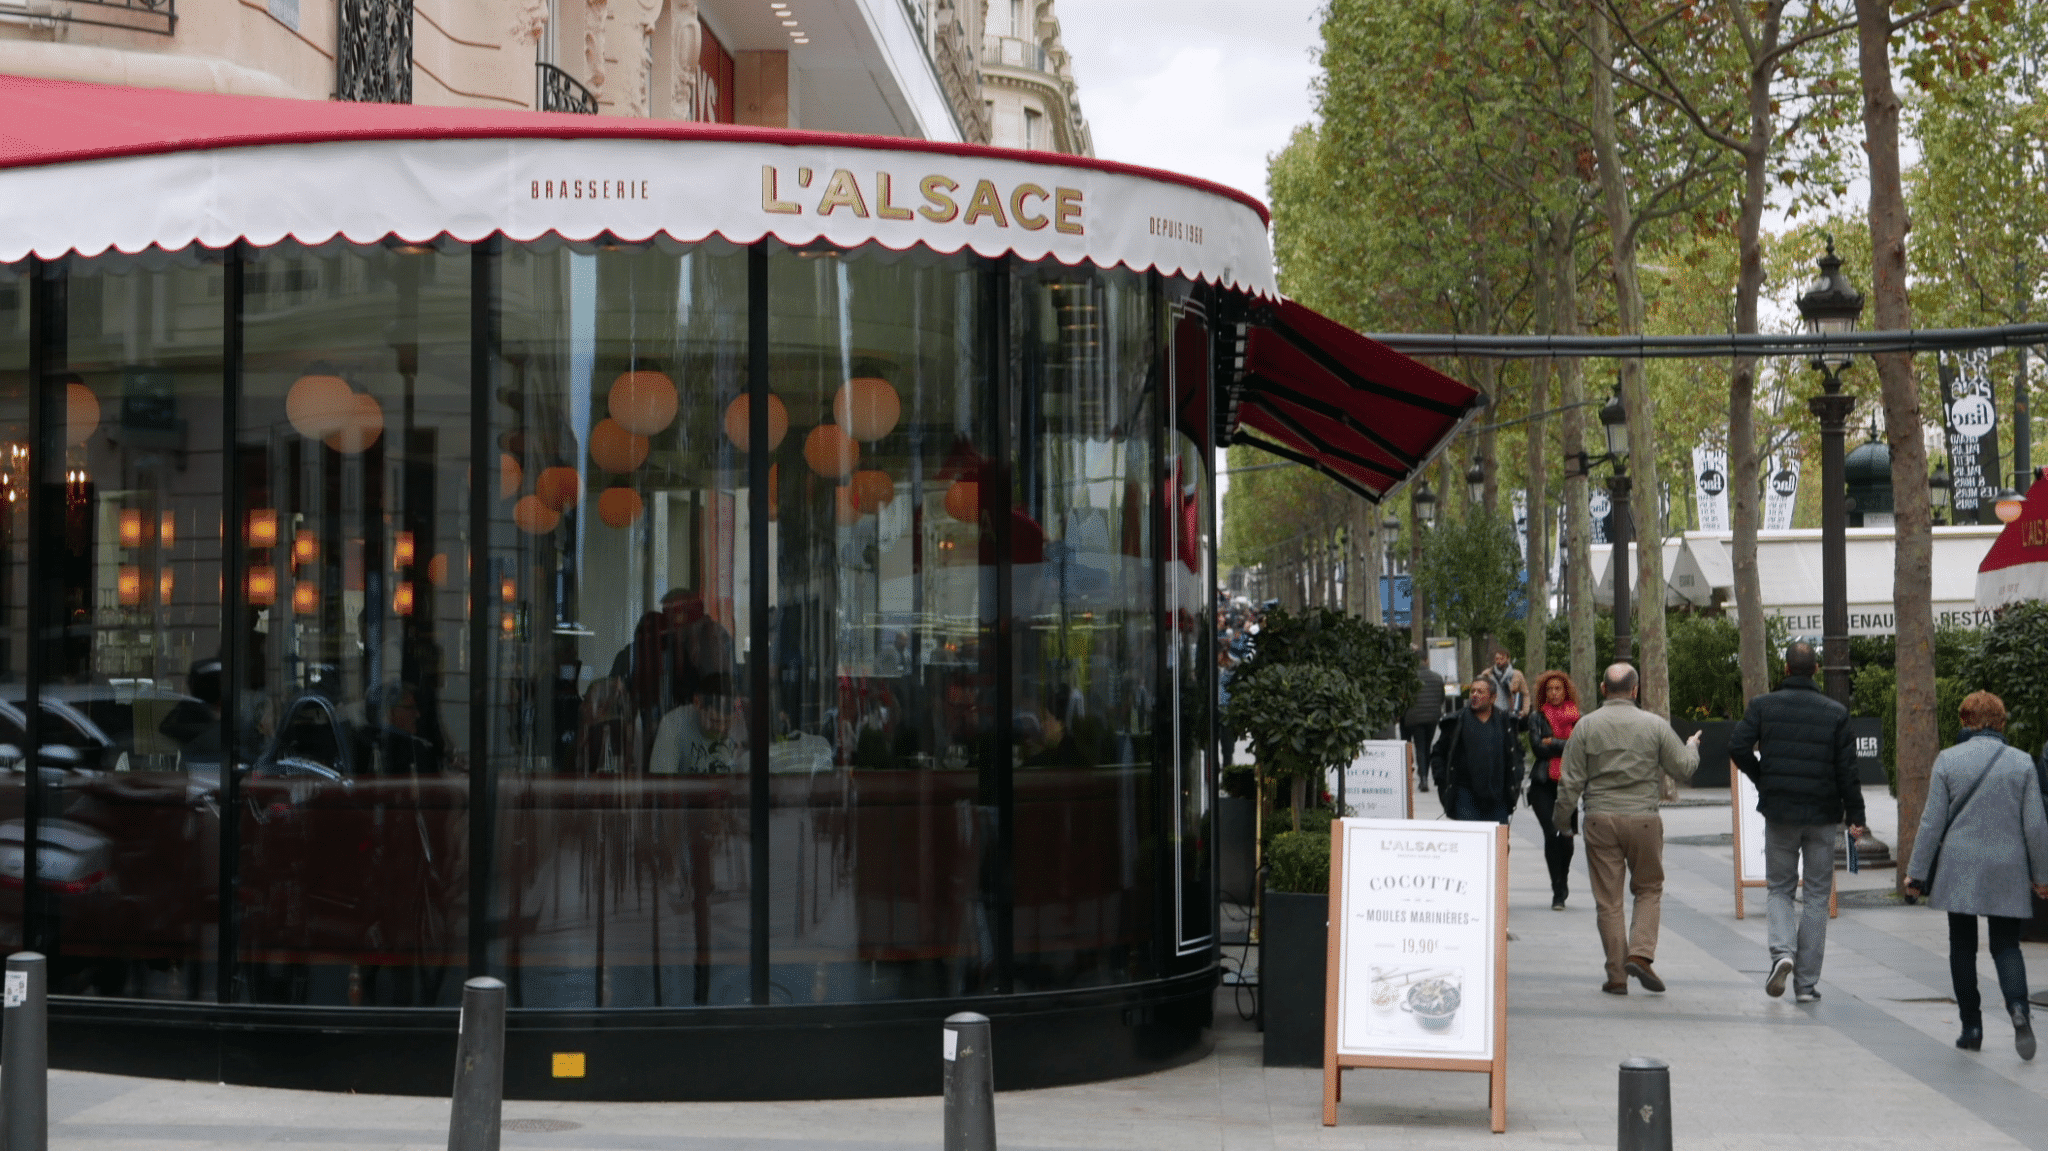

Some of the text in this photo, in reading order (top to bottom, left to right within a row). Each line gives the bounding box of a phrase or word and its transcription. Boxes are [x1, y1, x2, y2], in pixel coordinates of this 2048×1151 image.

[531, 180, 649, 199] BRASSERIE
[762, 164, 1084, 235] L'ALSACE
[1149, 216, 1182, 241] DEPUIS
[1380, 839, 1459, 853] L'ALSACE
[1369, 874, 1469, 895] COCOTTE
[1366, 908, 1470, 926] MOULES MARINIÈRES
